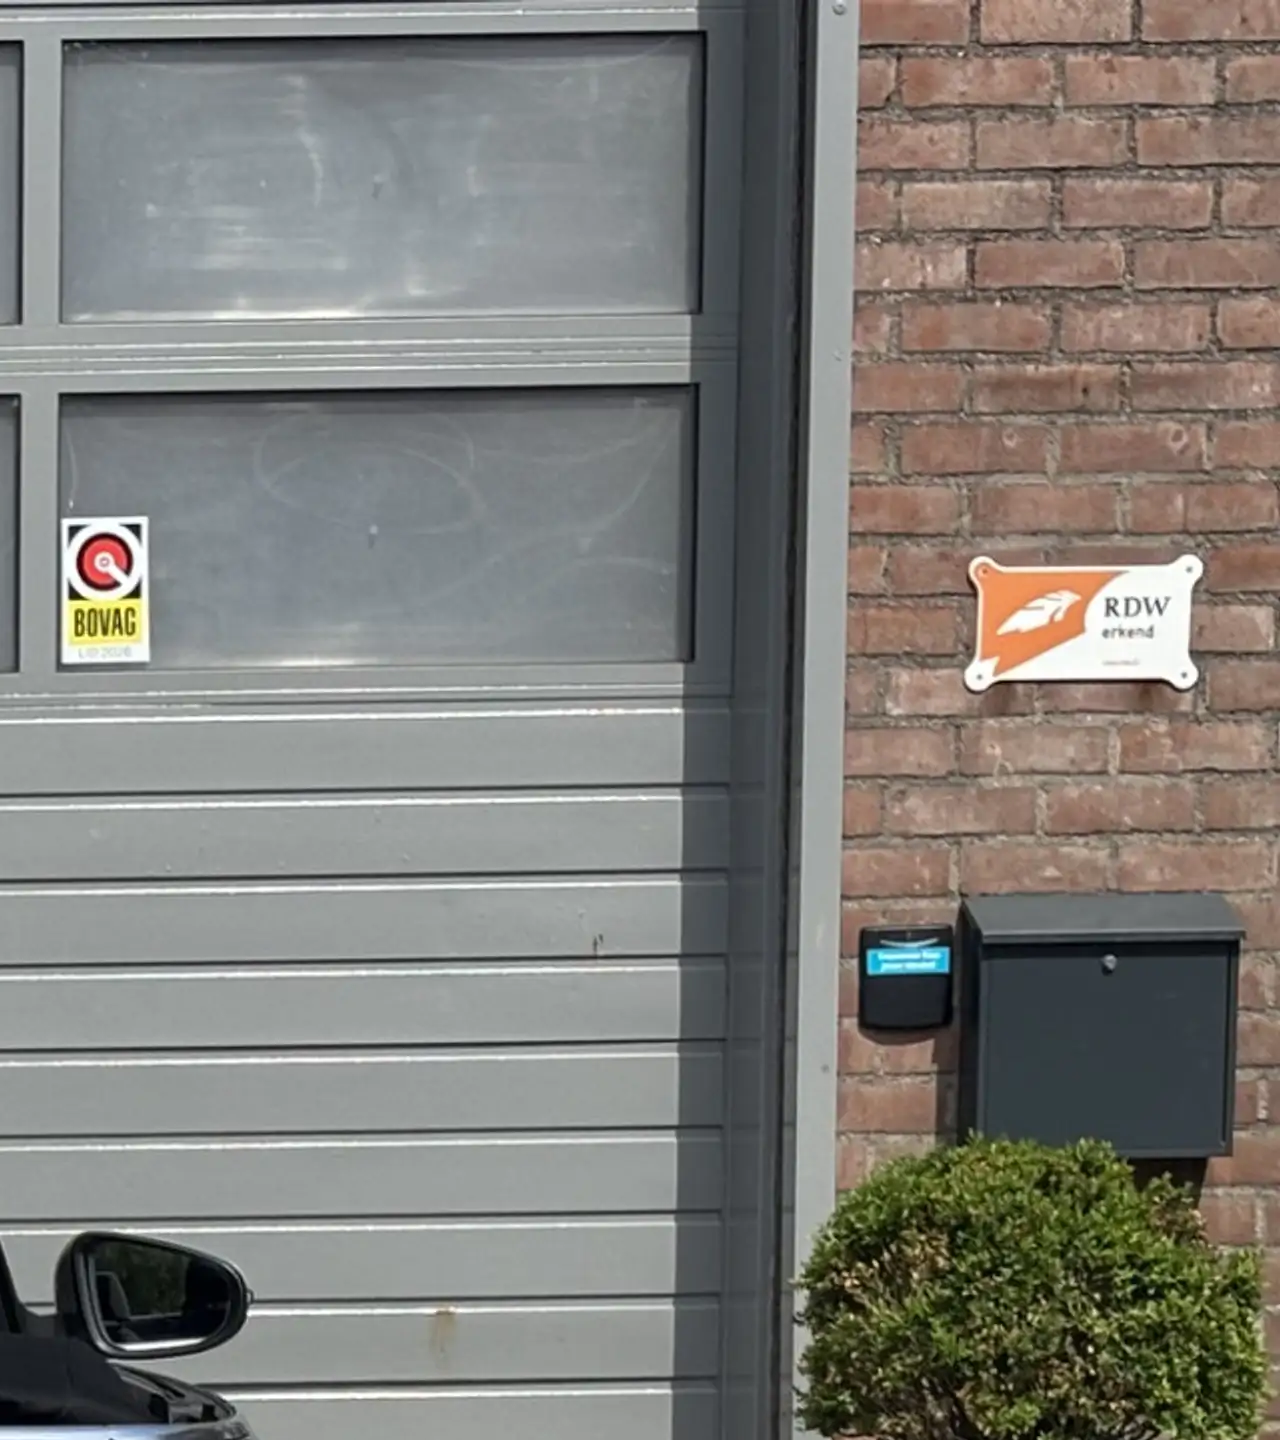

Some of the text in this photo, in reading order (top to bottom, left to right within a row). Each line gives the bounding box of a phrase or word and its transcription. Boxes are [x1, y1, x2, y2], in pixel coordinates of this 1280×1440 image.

[1104, 597, 1171, 618] RDW
[74, 607, 136, 637] BOVAG
[1102, 625, 1154, 639] erkend
